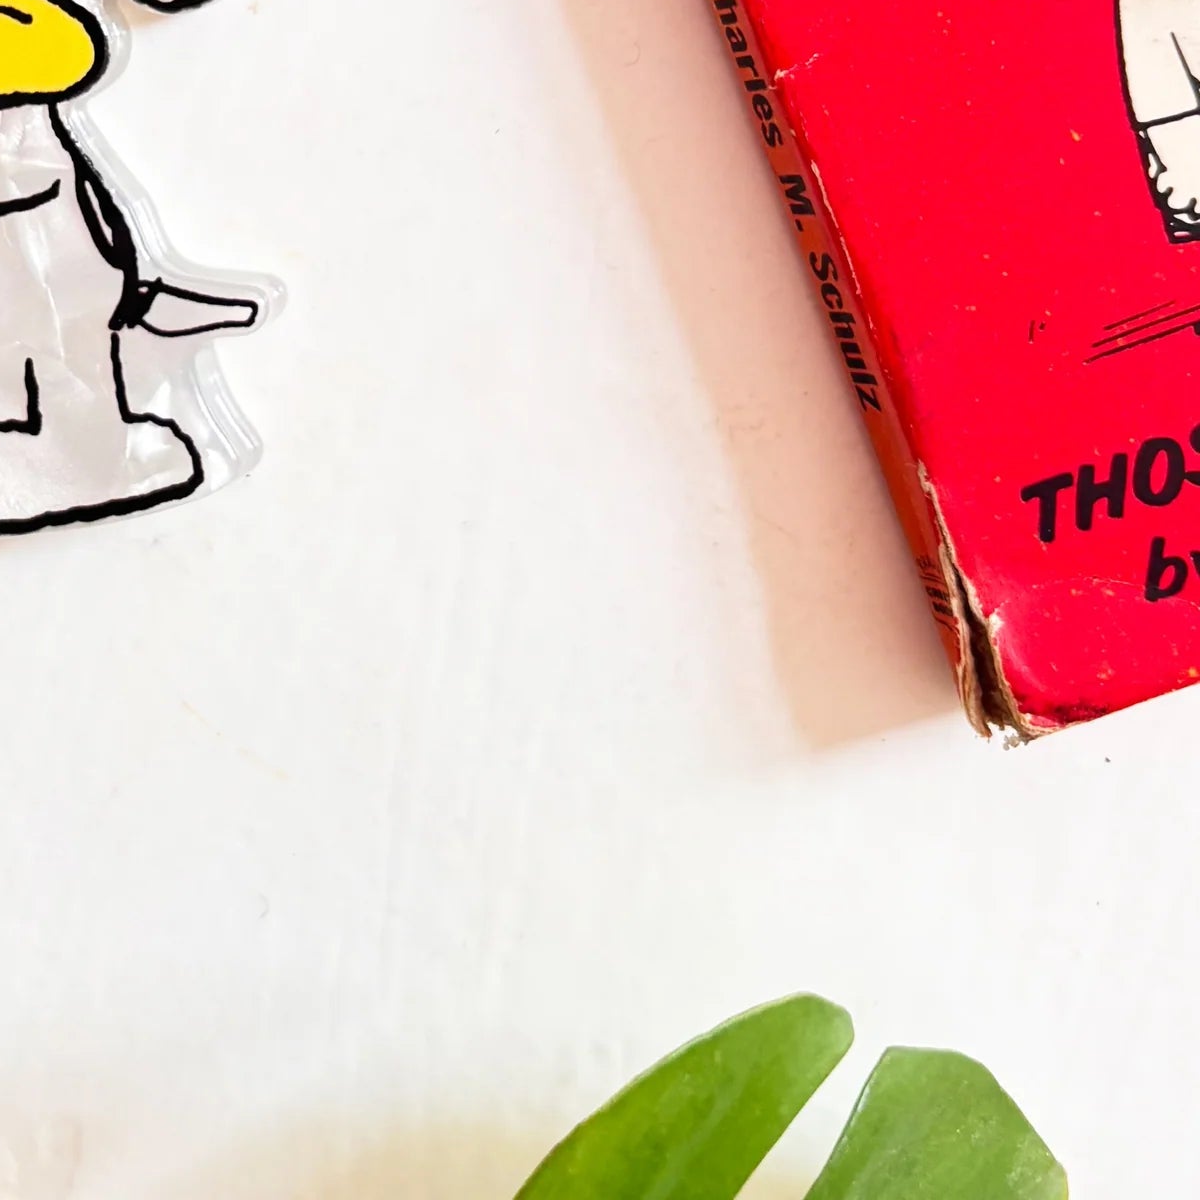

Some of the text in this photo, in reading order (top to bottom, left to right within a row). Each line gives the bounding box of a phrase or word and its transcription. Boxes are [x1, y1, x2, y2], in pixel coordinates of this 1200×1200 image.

[779, 174, 816, 233] M.
[808, 251, 883, 413] Schulz
[1144, 536, 1200, 603] b
